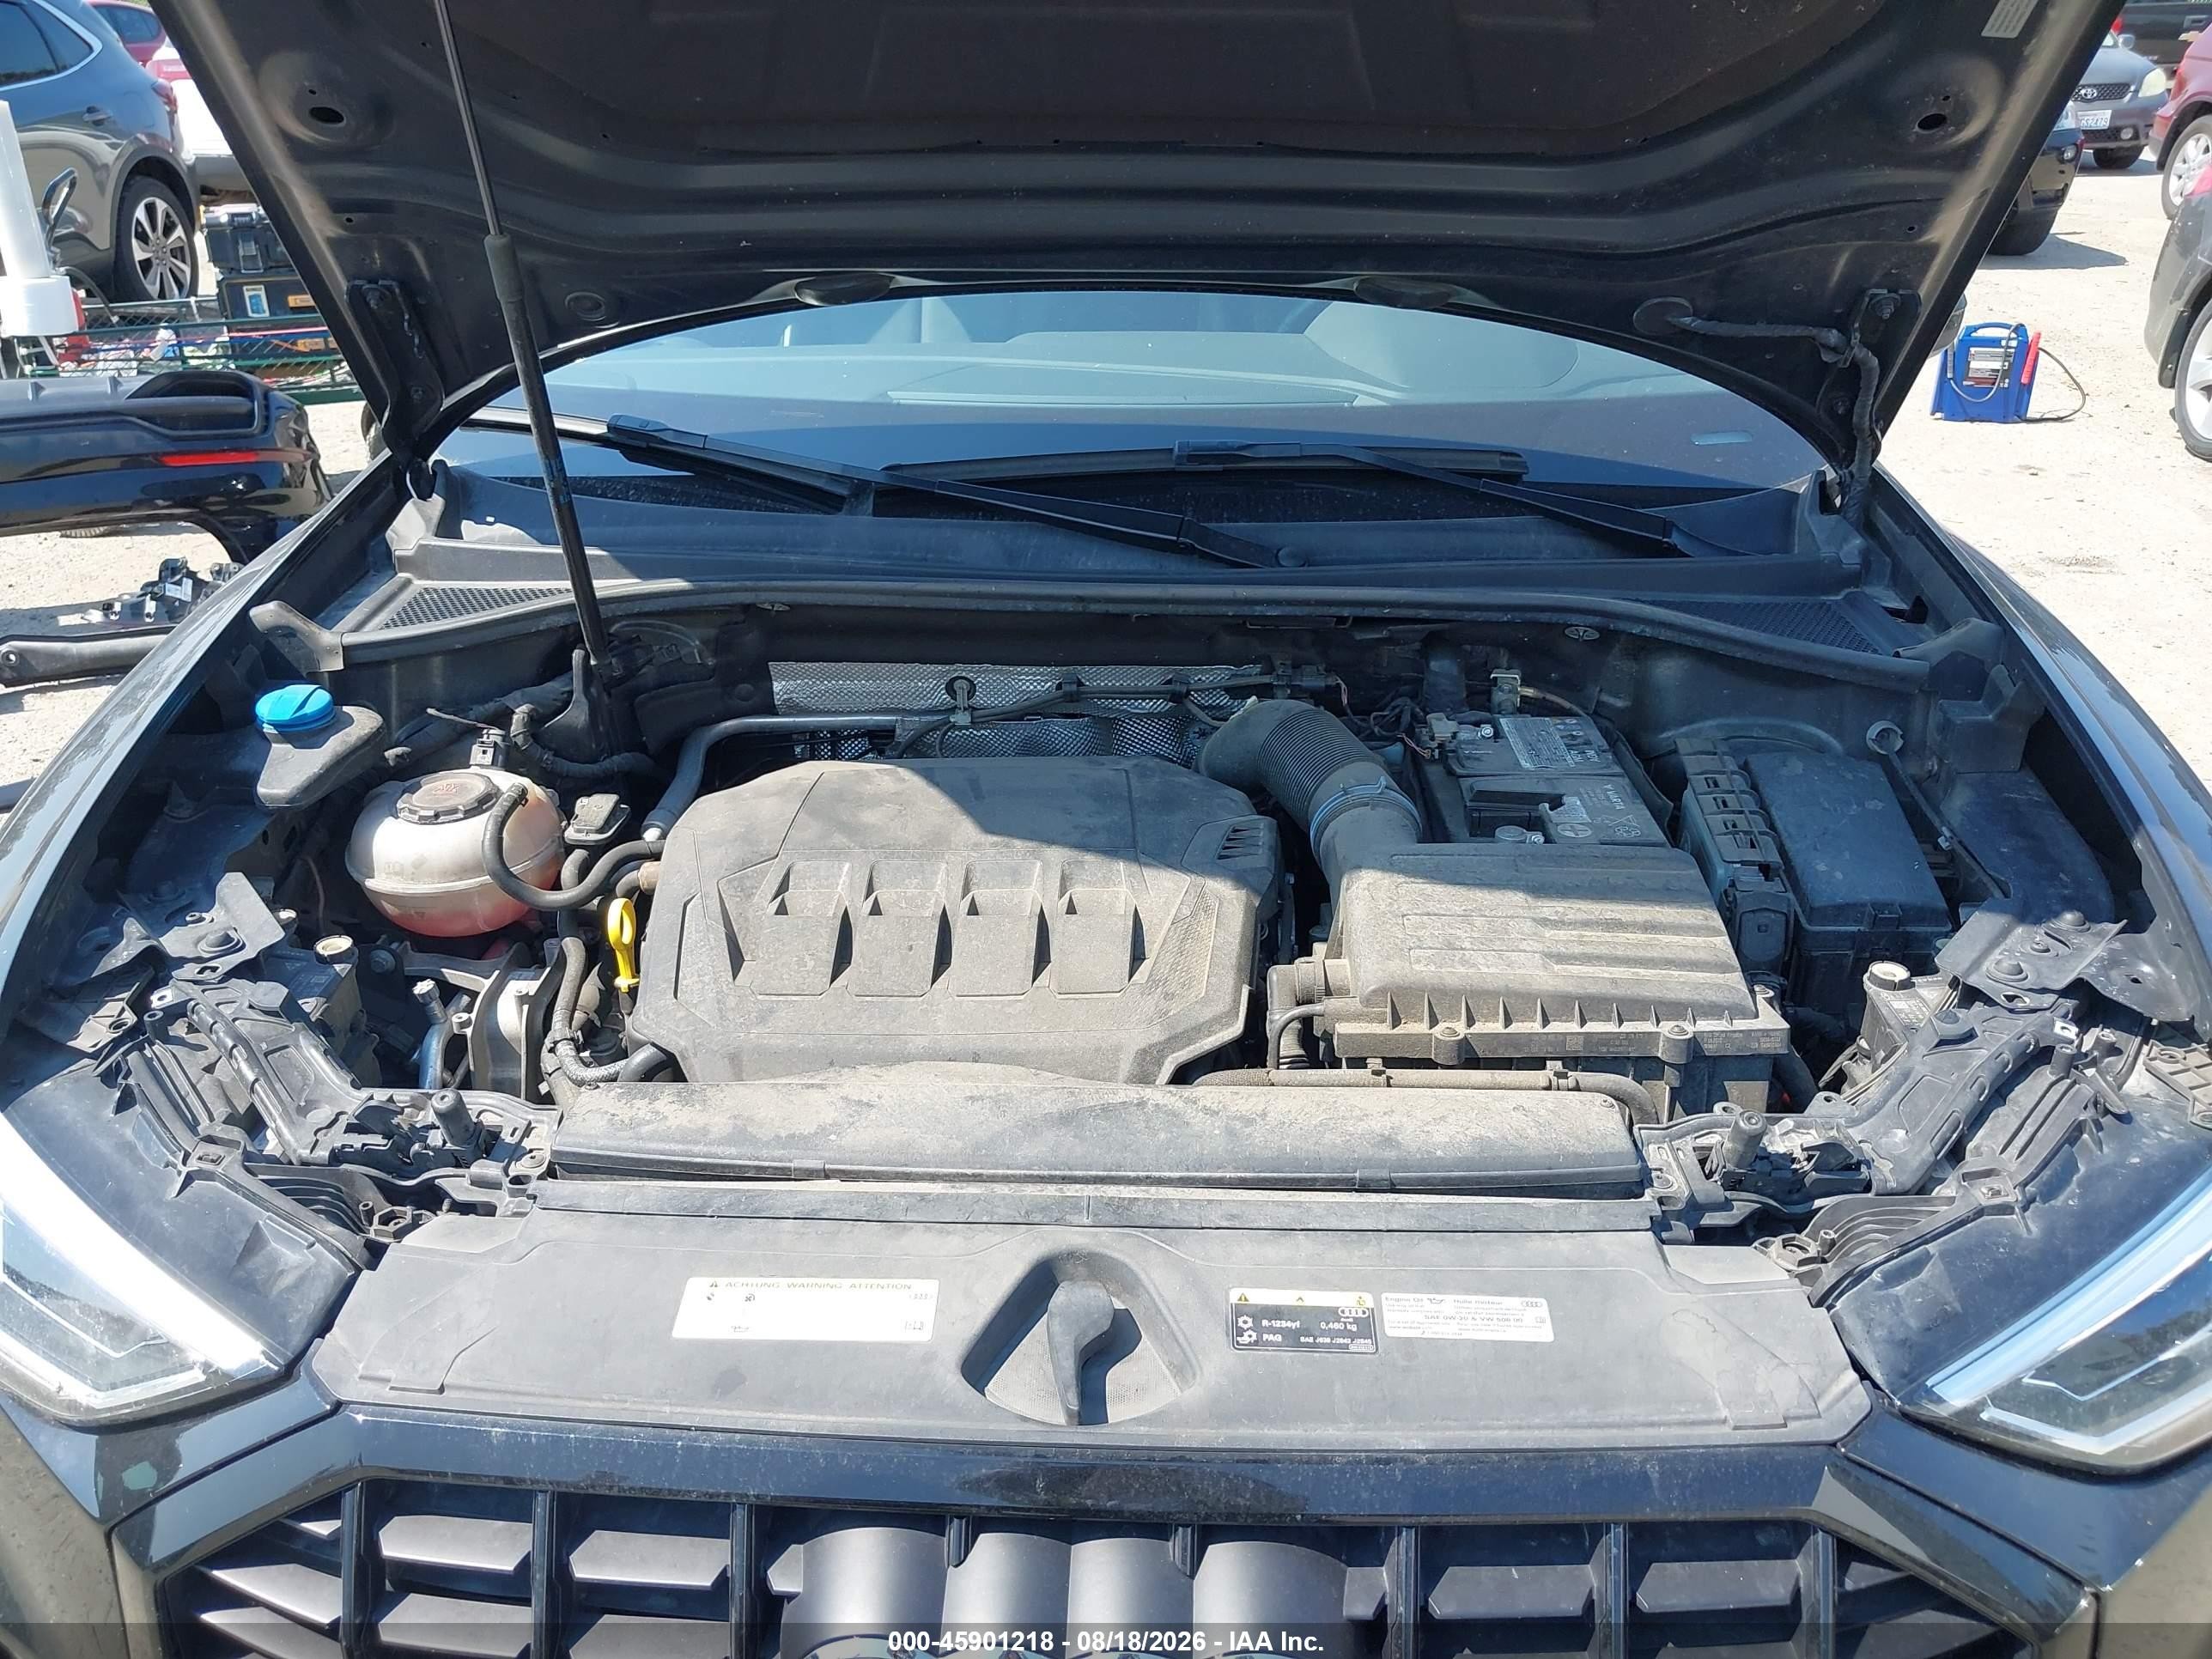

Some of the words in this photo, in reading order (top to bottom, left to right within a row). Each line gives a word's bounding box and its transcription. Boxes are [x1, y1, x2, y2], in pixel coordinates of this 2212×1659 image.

[1607, 790, 1626, 810] VARTA
[1261, 1320, 1301, 1330] R-1234yf
[1346, 1322, 1358, 1331] kg
